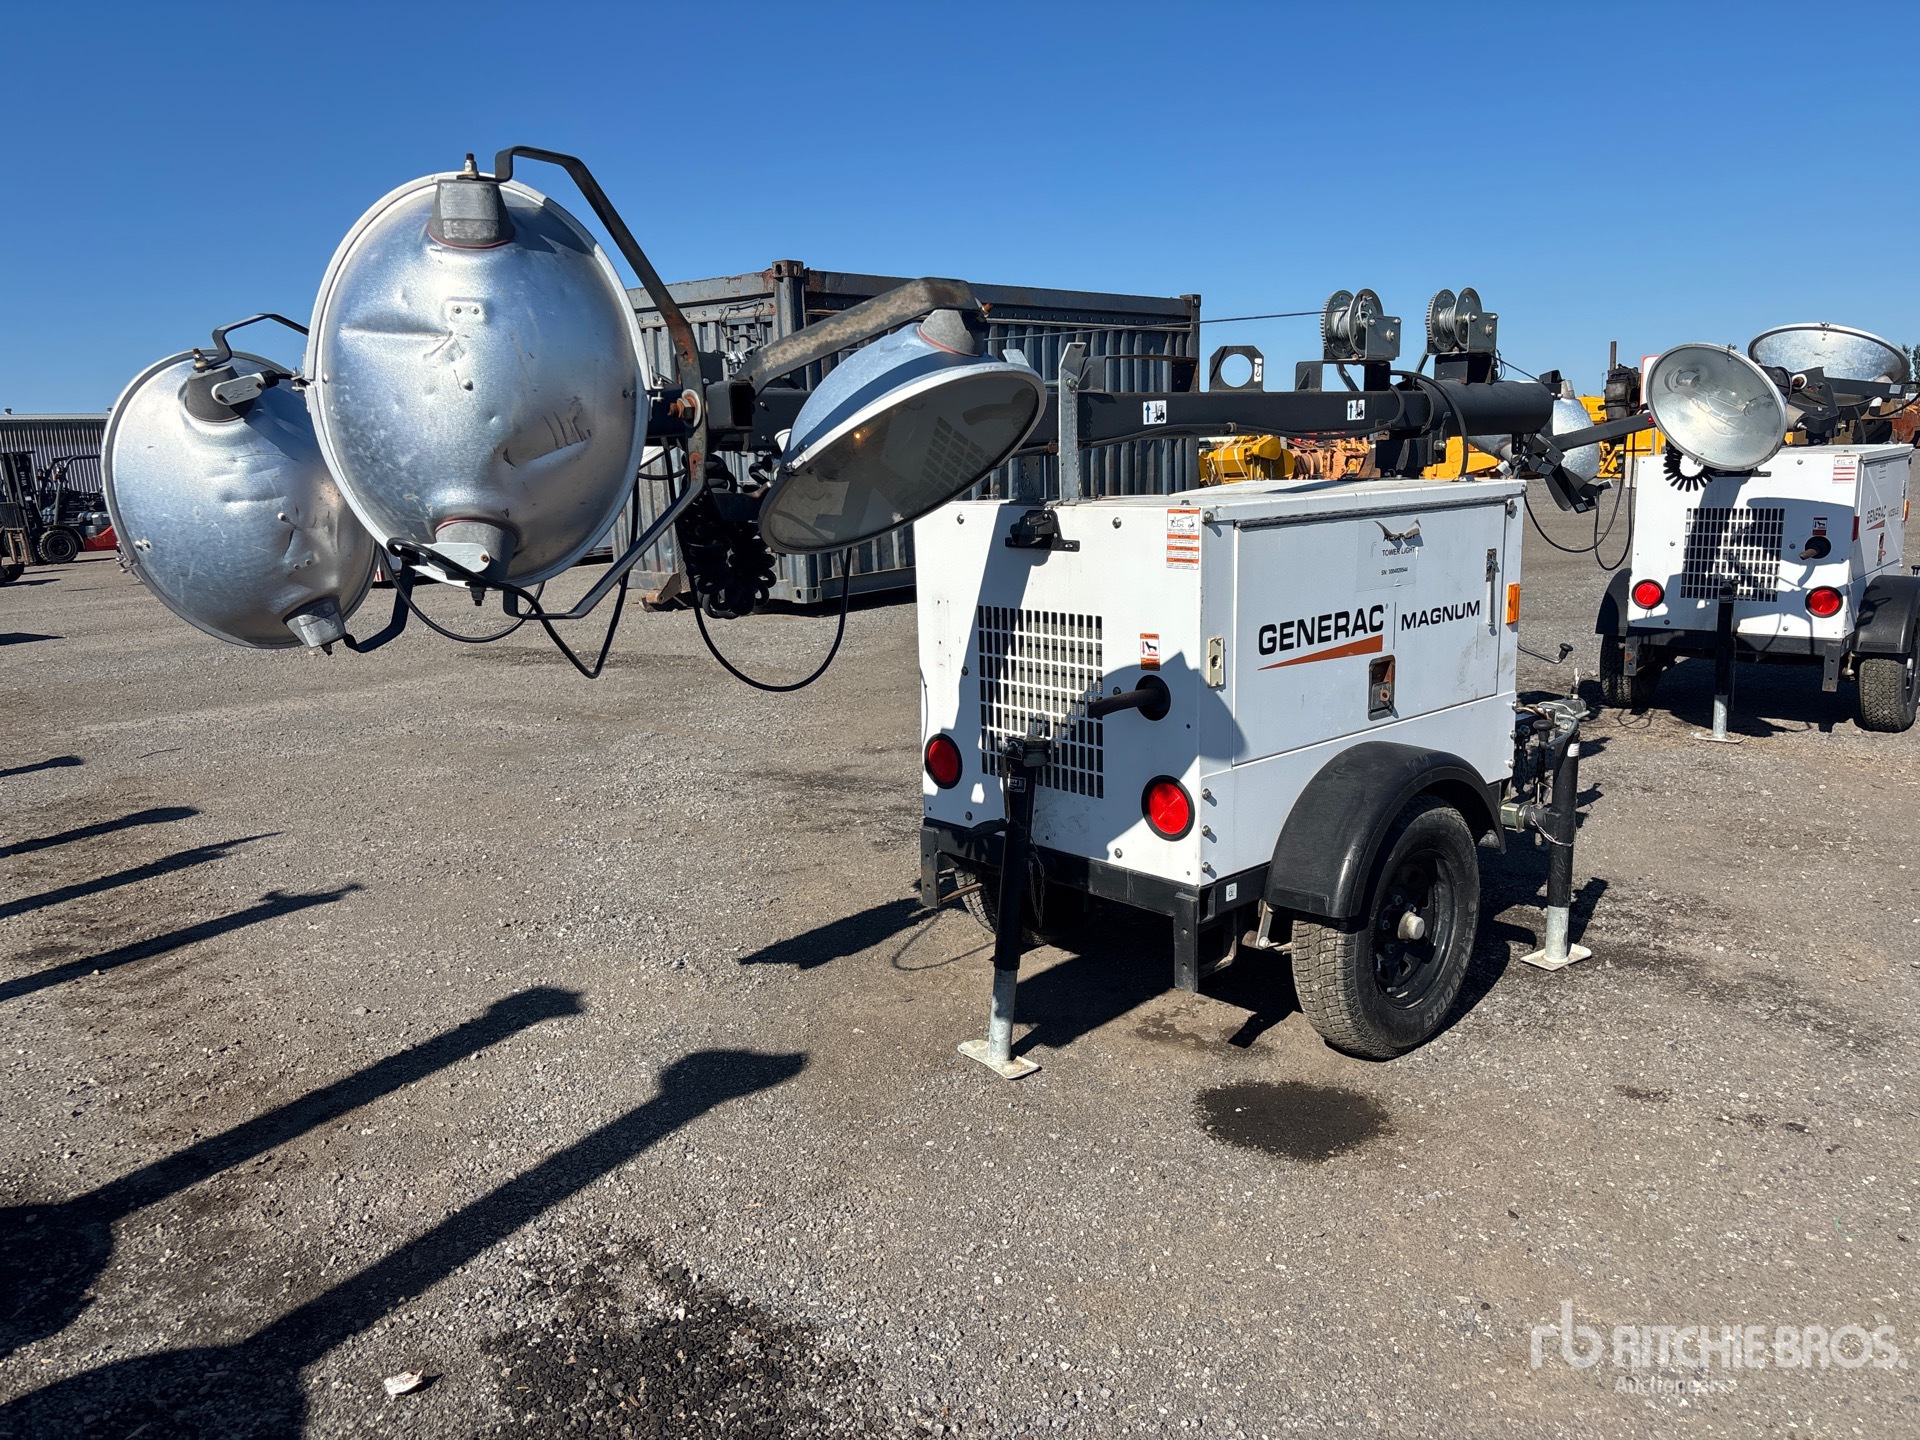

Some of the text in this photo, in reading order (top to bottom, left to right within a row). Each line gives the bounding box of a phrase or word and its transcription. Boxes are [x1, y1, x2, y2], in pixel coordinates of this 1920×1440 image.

[1382, 546, 1415, 556] TOWER LIGHT
[1258, 600, 1480, 656] GENERAC MAGNUM
